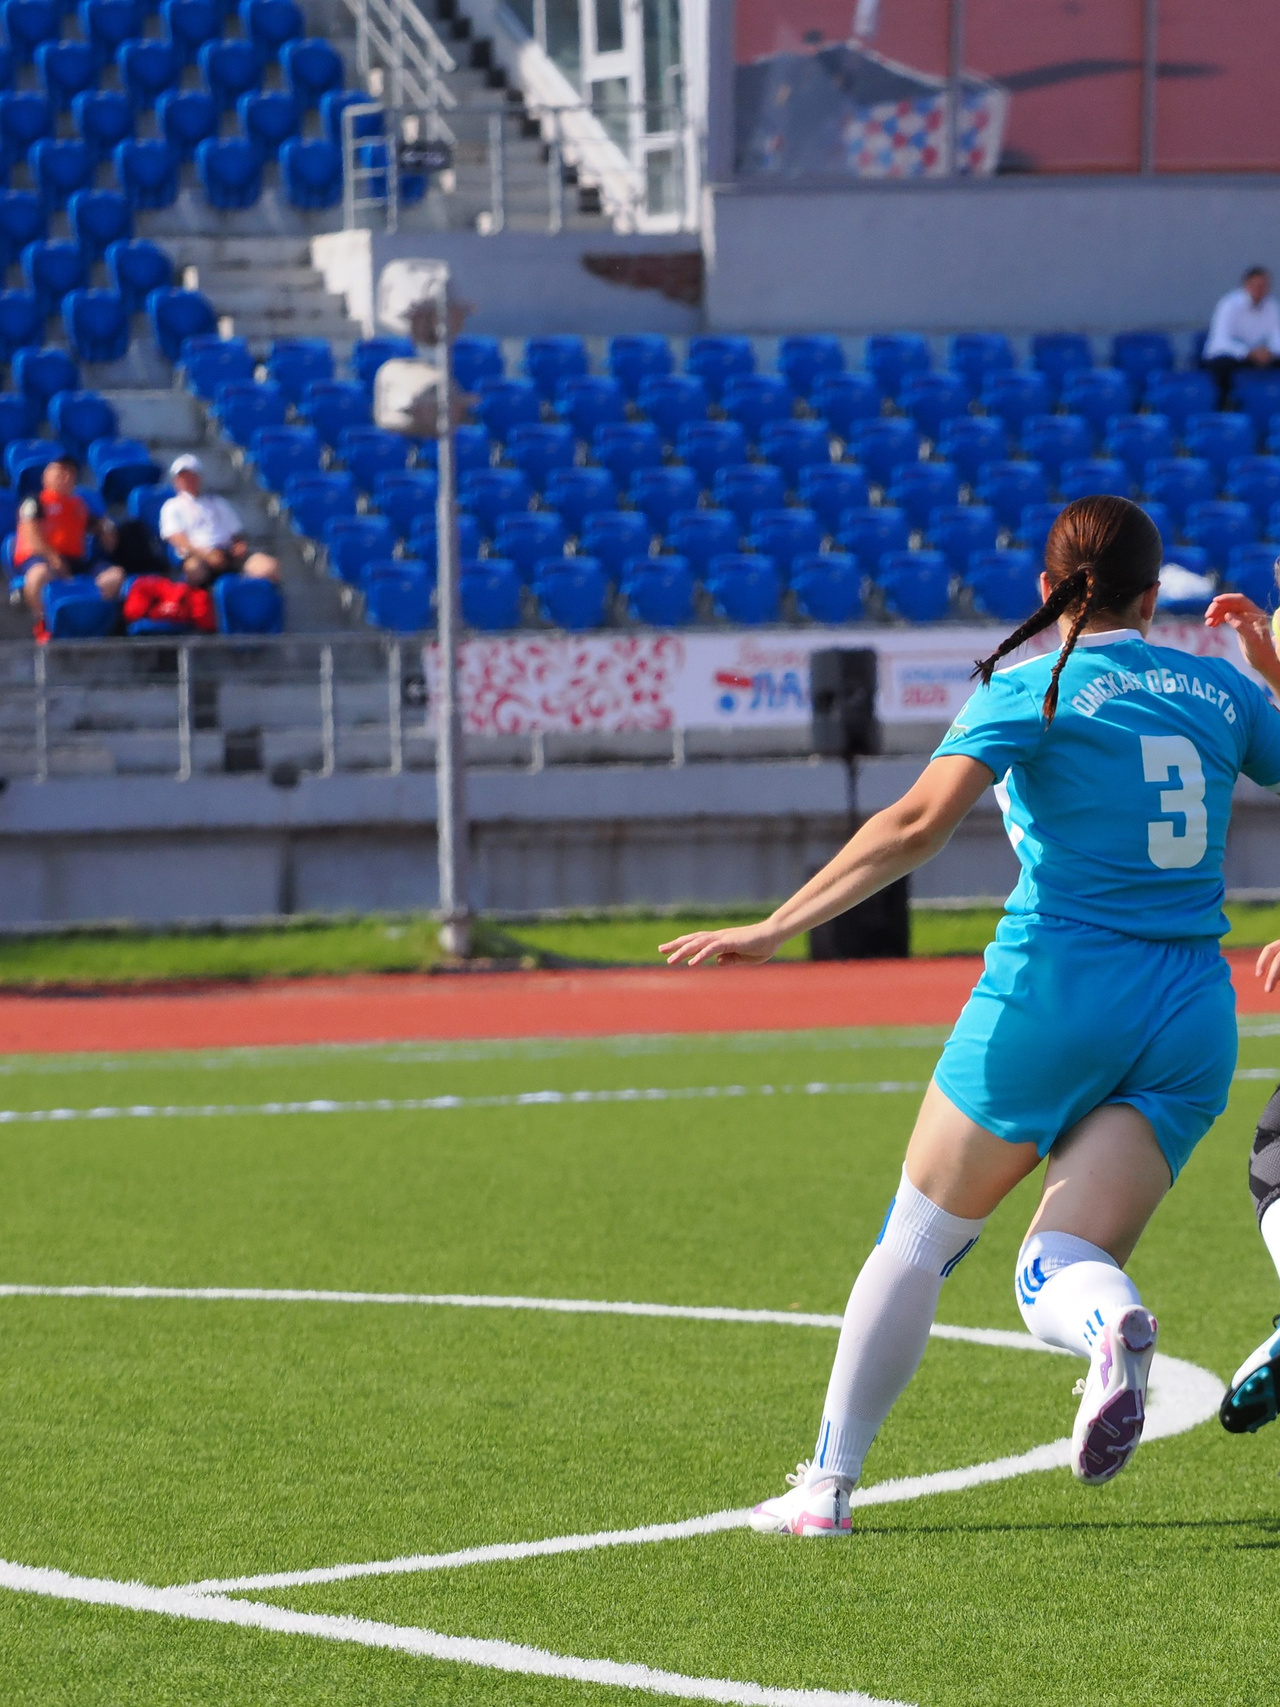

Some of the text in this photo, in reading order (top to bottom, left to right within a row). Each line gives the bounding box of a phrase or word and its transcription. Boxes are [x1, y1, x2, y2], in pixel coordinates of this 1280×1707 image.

[1071, 668, 1237, 724] ОМСКАЯ ОБЛАСТЬ
[1139, 735, 1207, 869] 3
